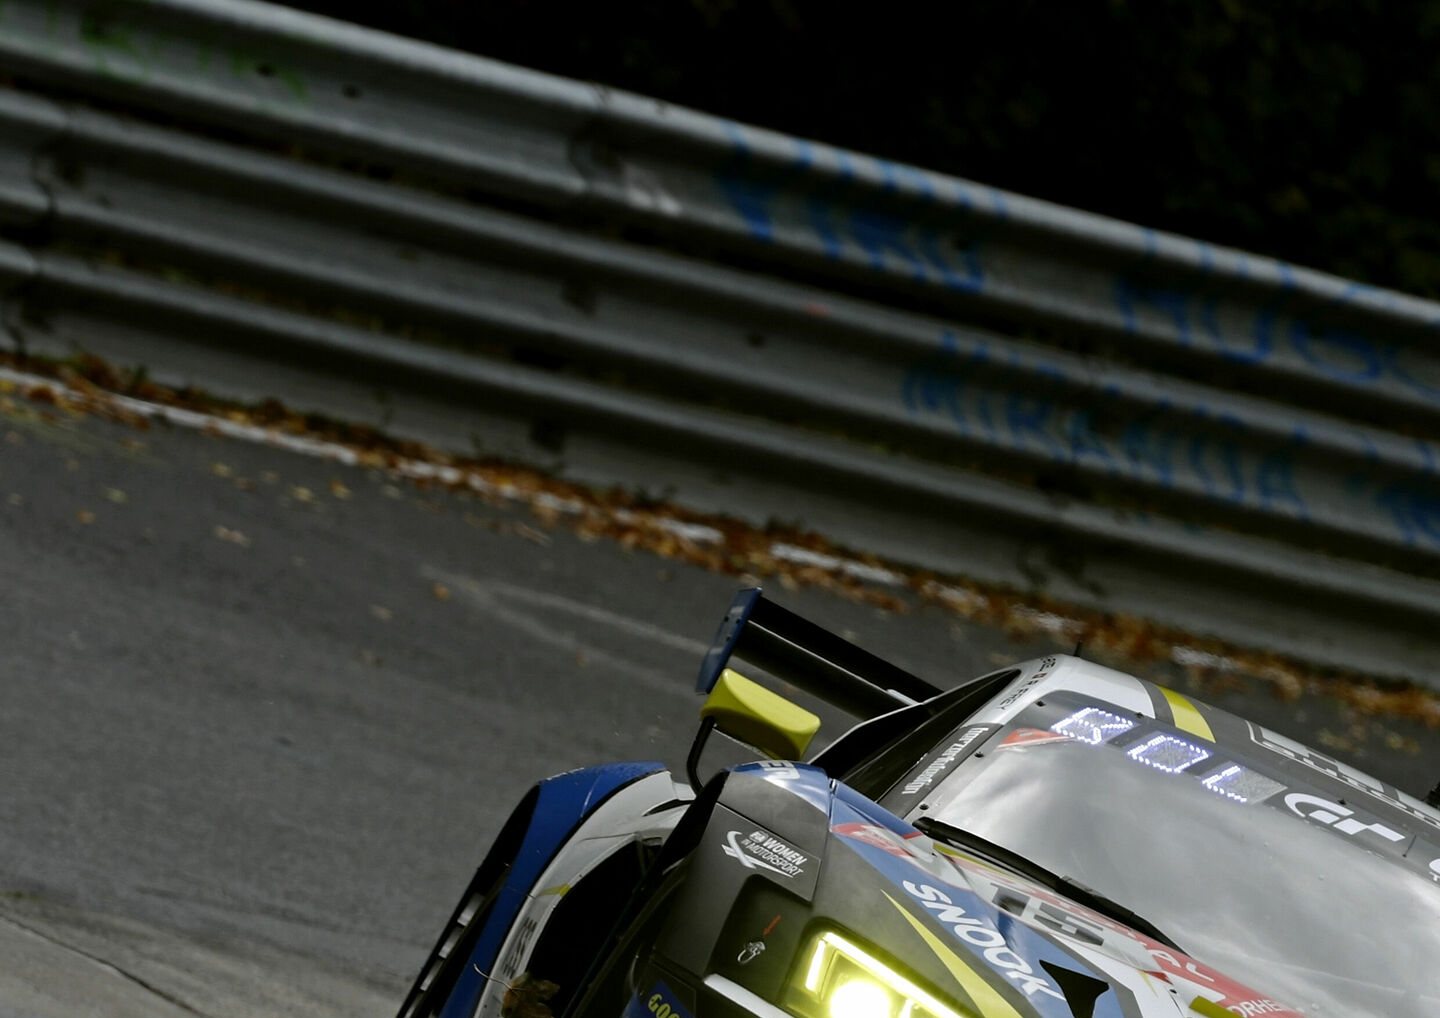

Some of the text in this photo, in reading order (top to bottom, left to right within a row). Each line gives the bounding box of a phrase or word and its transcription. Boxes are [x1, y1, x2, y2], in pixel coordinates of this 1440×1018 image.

[745, 842, 804, 876] MOTORSPORT
[763, 837, 808, 866] WOMEN
[990, 882, 1105, 946] 15
[902, 879, 1068, 1002] SNOOK
